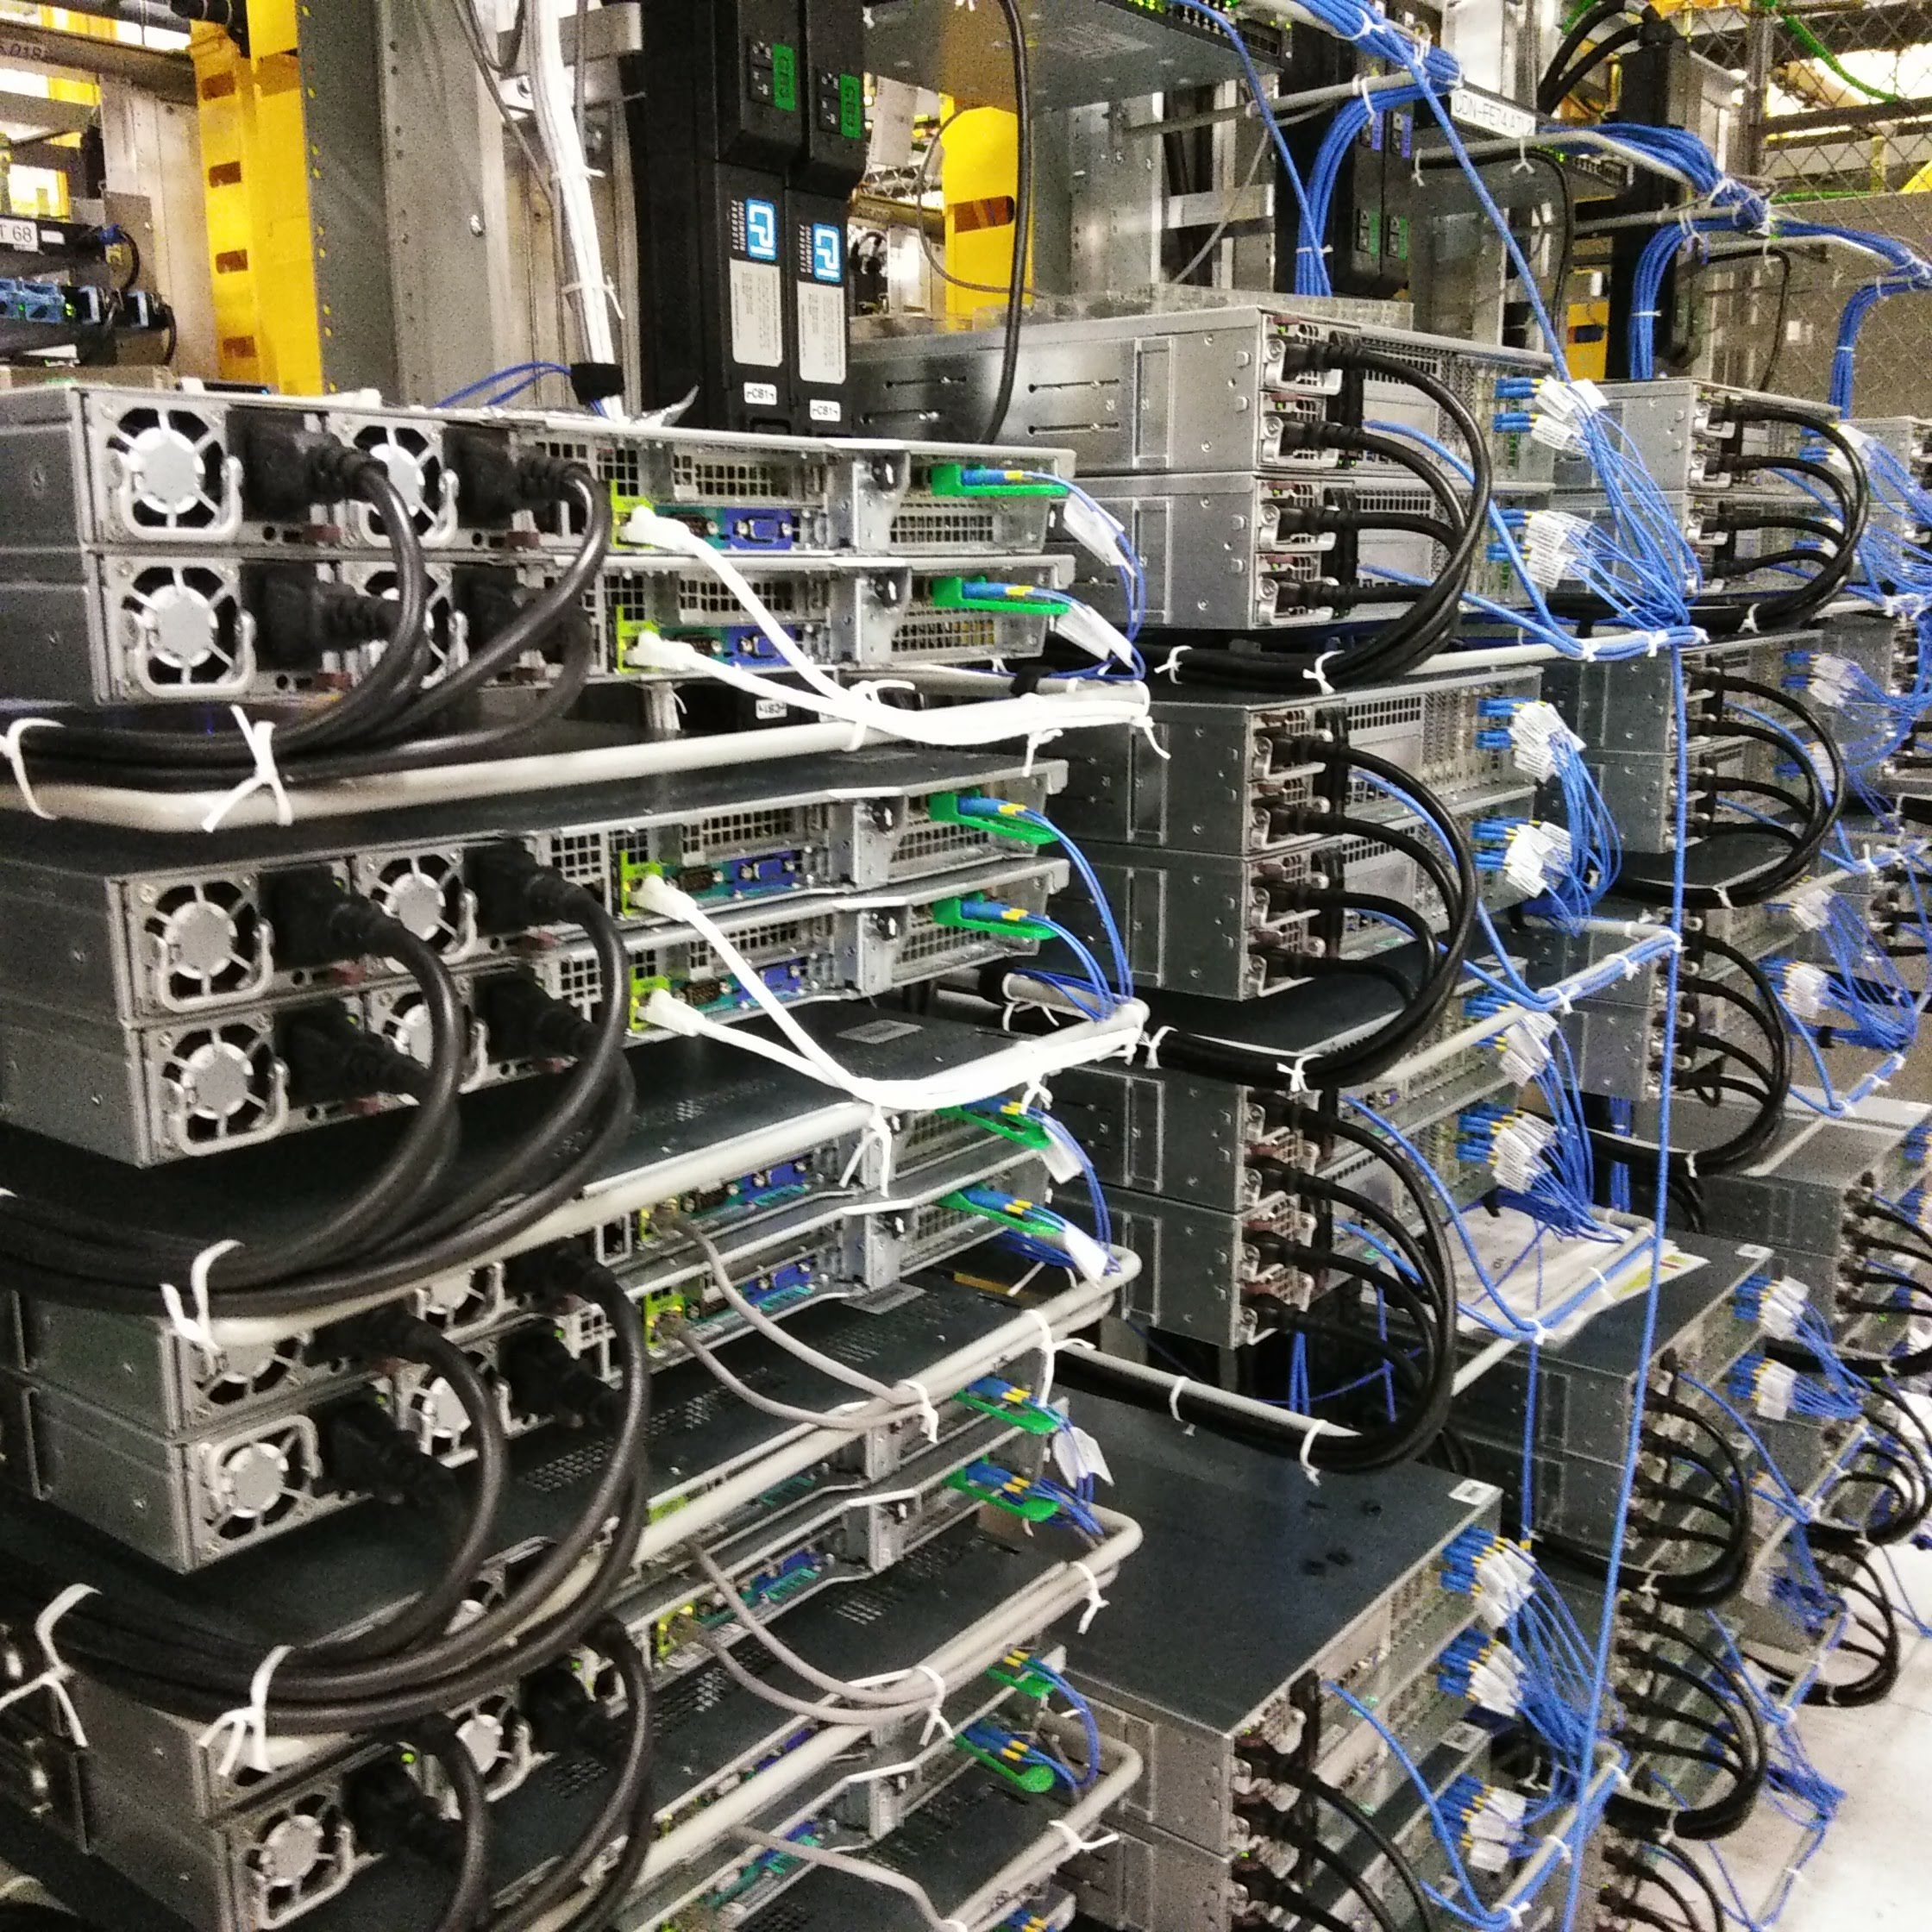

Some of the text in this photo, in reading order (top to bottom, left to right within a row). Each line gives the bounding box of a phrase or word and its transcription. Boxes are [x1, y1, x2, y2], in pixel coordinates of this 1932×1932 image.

[13, 226, 32, 242] 68
[748, 204, 775, 256] CPI
[815, 228, 840, 278] CPI
